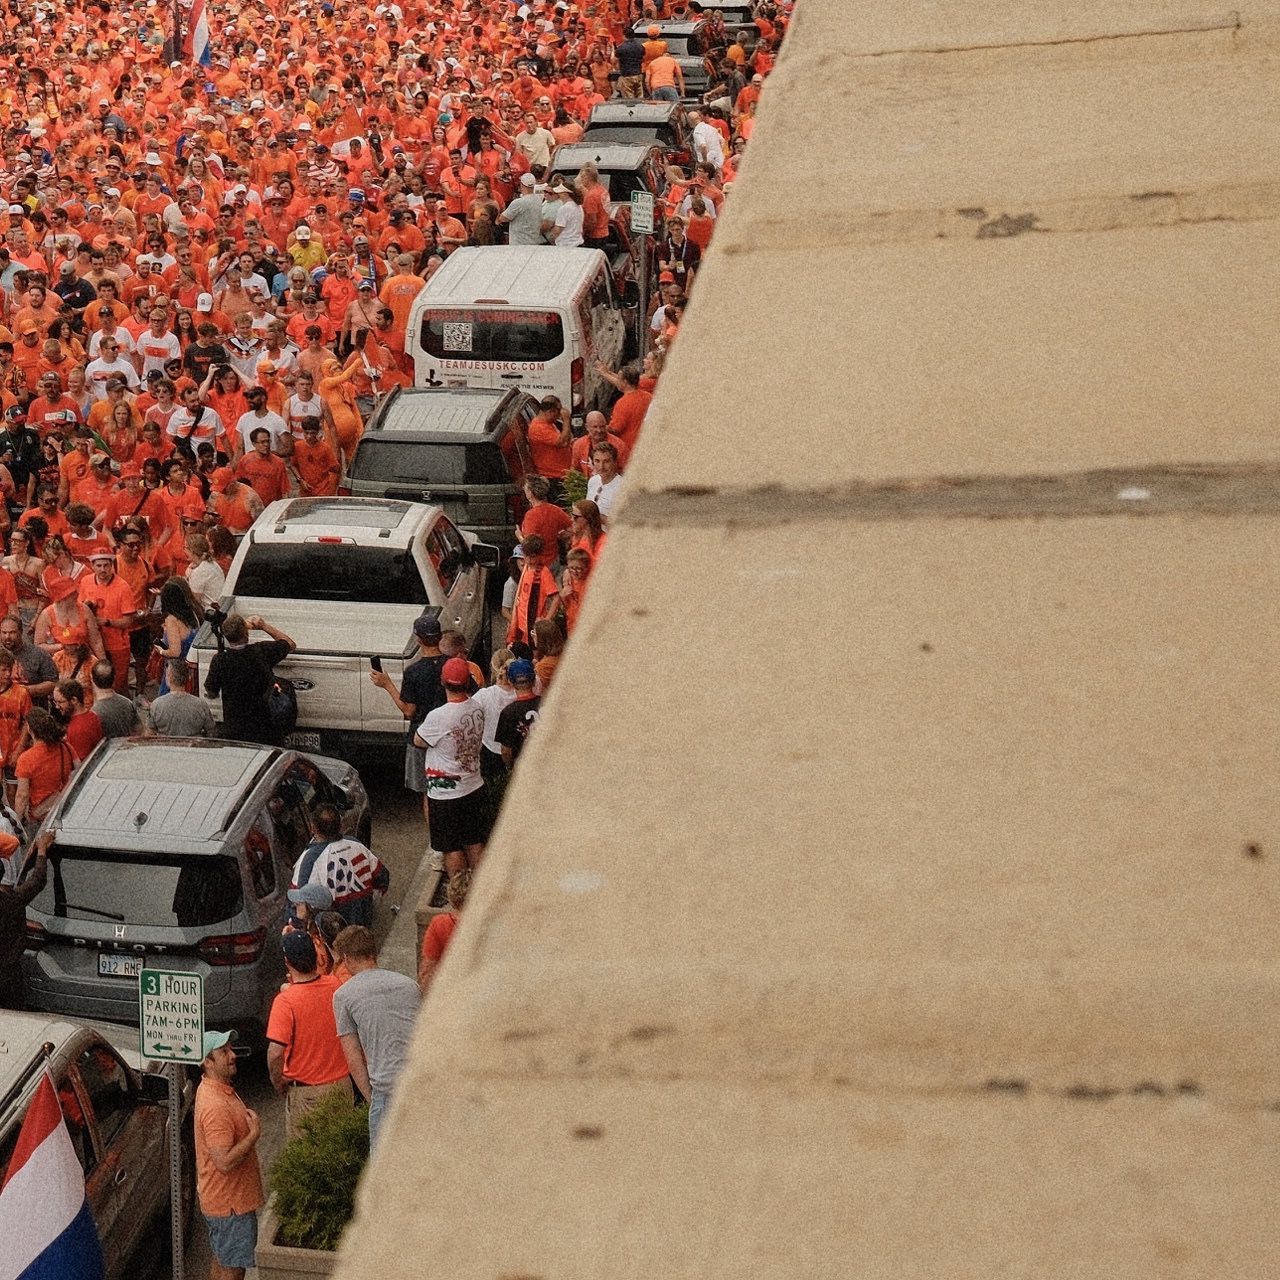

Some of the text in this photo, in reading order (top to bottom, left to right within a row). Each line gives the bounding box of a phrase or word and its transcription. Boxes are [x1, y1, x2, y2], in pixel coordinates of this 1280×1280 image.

[439, 360, 545, 371] TEAMJESUSKC.COM
[73, 938, 167, 952] PILOT
[101, 960, 118, 974] 912
[147, 976, 197, 996] 3 HOUR
[146, 999, 198, 1014] PARKING
[145, 1014, 199, 1030] 7AM-6PM
[146, 1030, 163, 1040] MON
